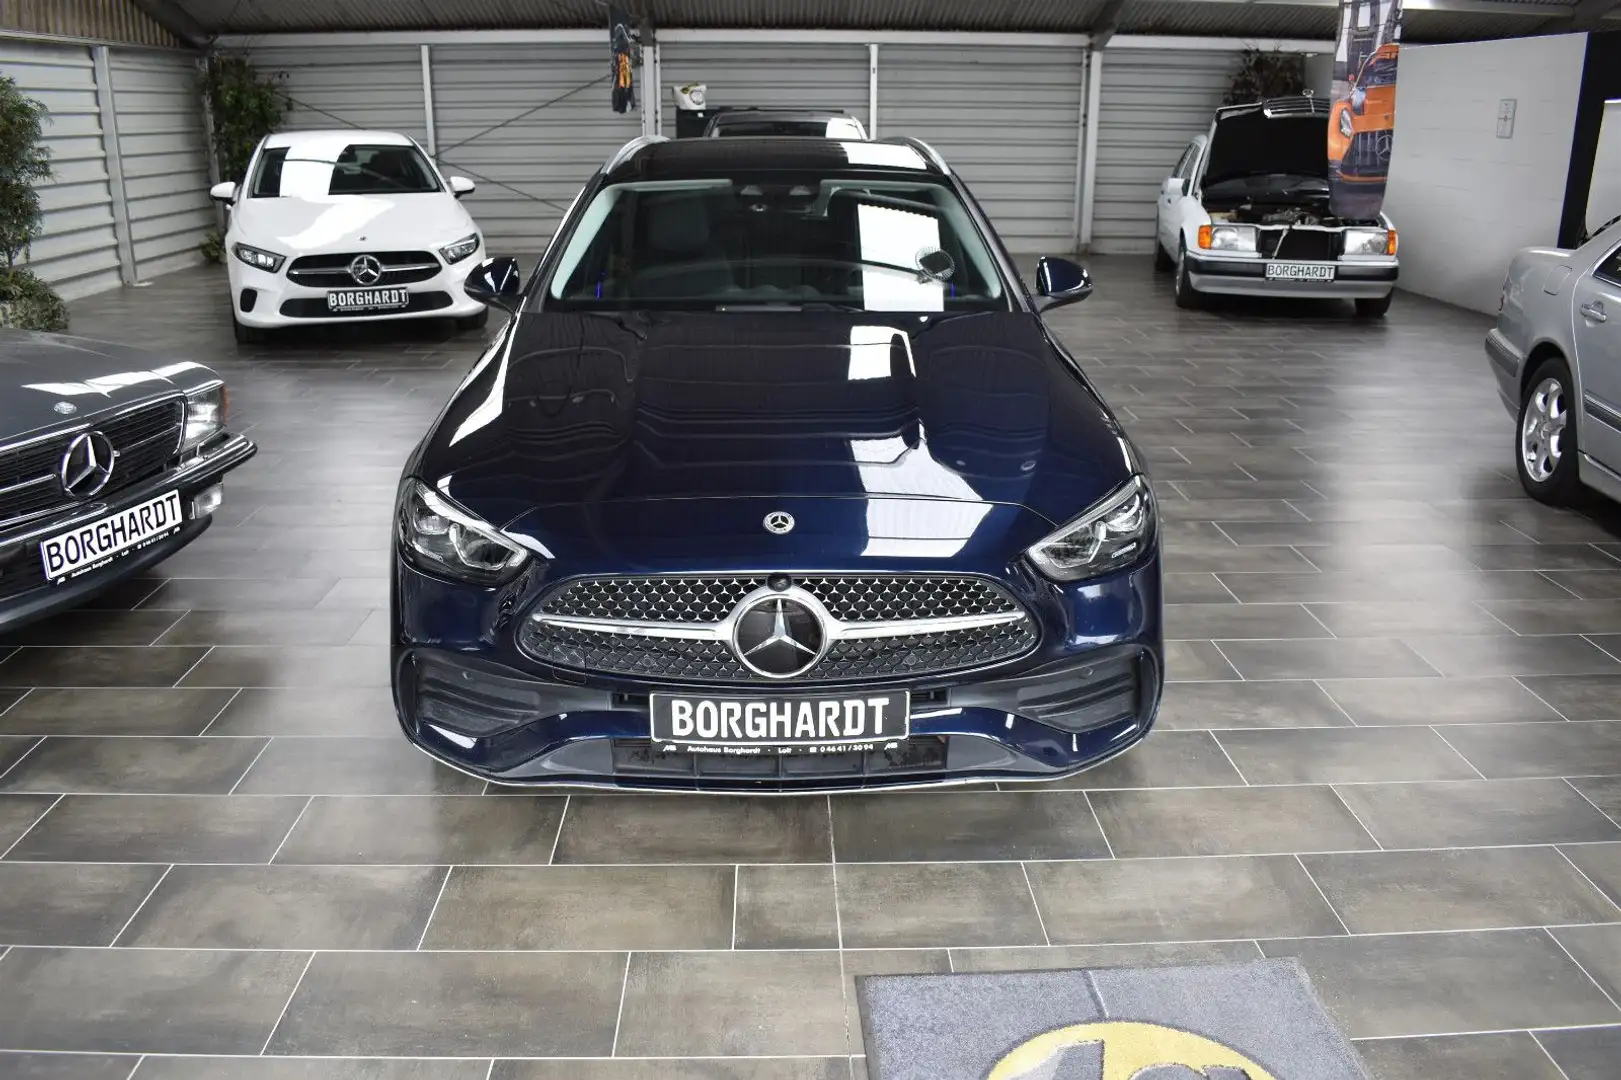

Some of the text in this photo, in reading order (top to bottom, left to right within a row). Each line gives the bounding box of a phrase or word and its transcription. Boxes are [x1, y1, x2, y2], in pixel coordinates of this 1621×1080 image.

[1268, 265, 1334, 277] BORGHARDT
[329, 290, 406, 305] BORGHARDT
[46, 494, 177, 572] BORGHARDT
[671, 697, 889, 738] BORGHARDT
[687, 745, 722, 753] Autohaus
[723, 747, 761, 755] Borghardt
